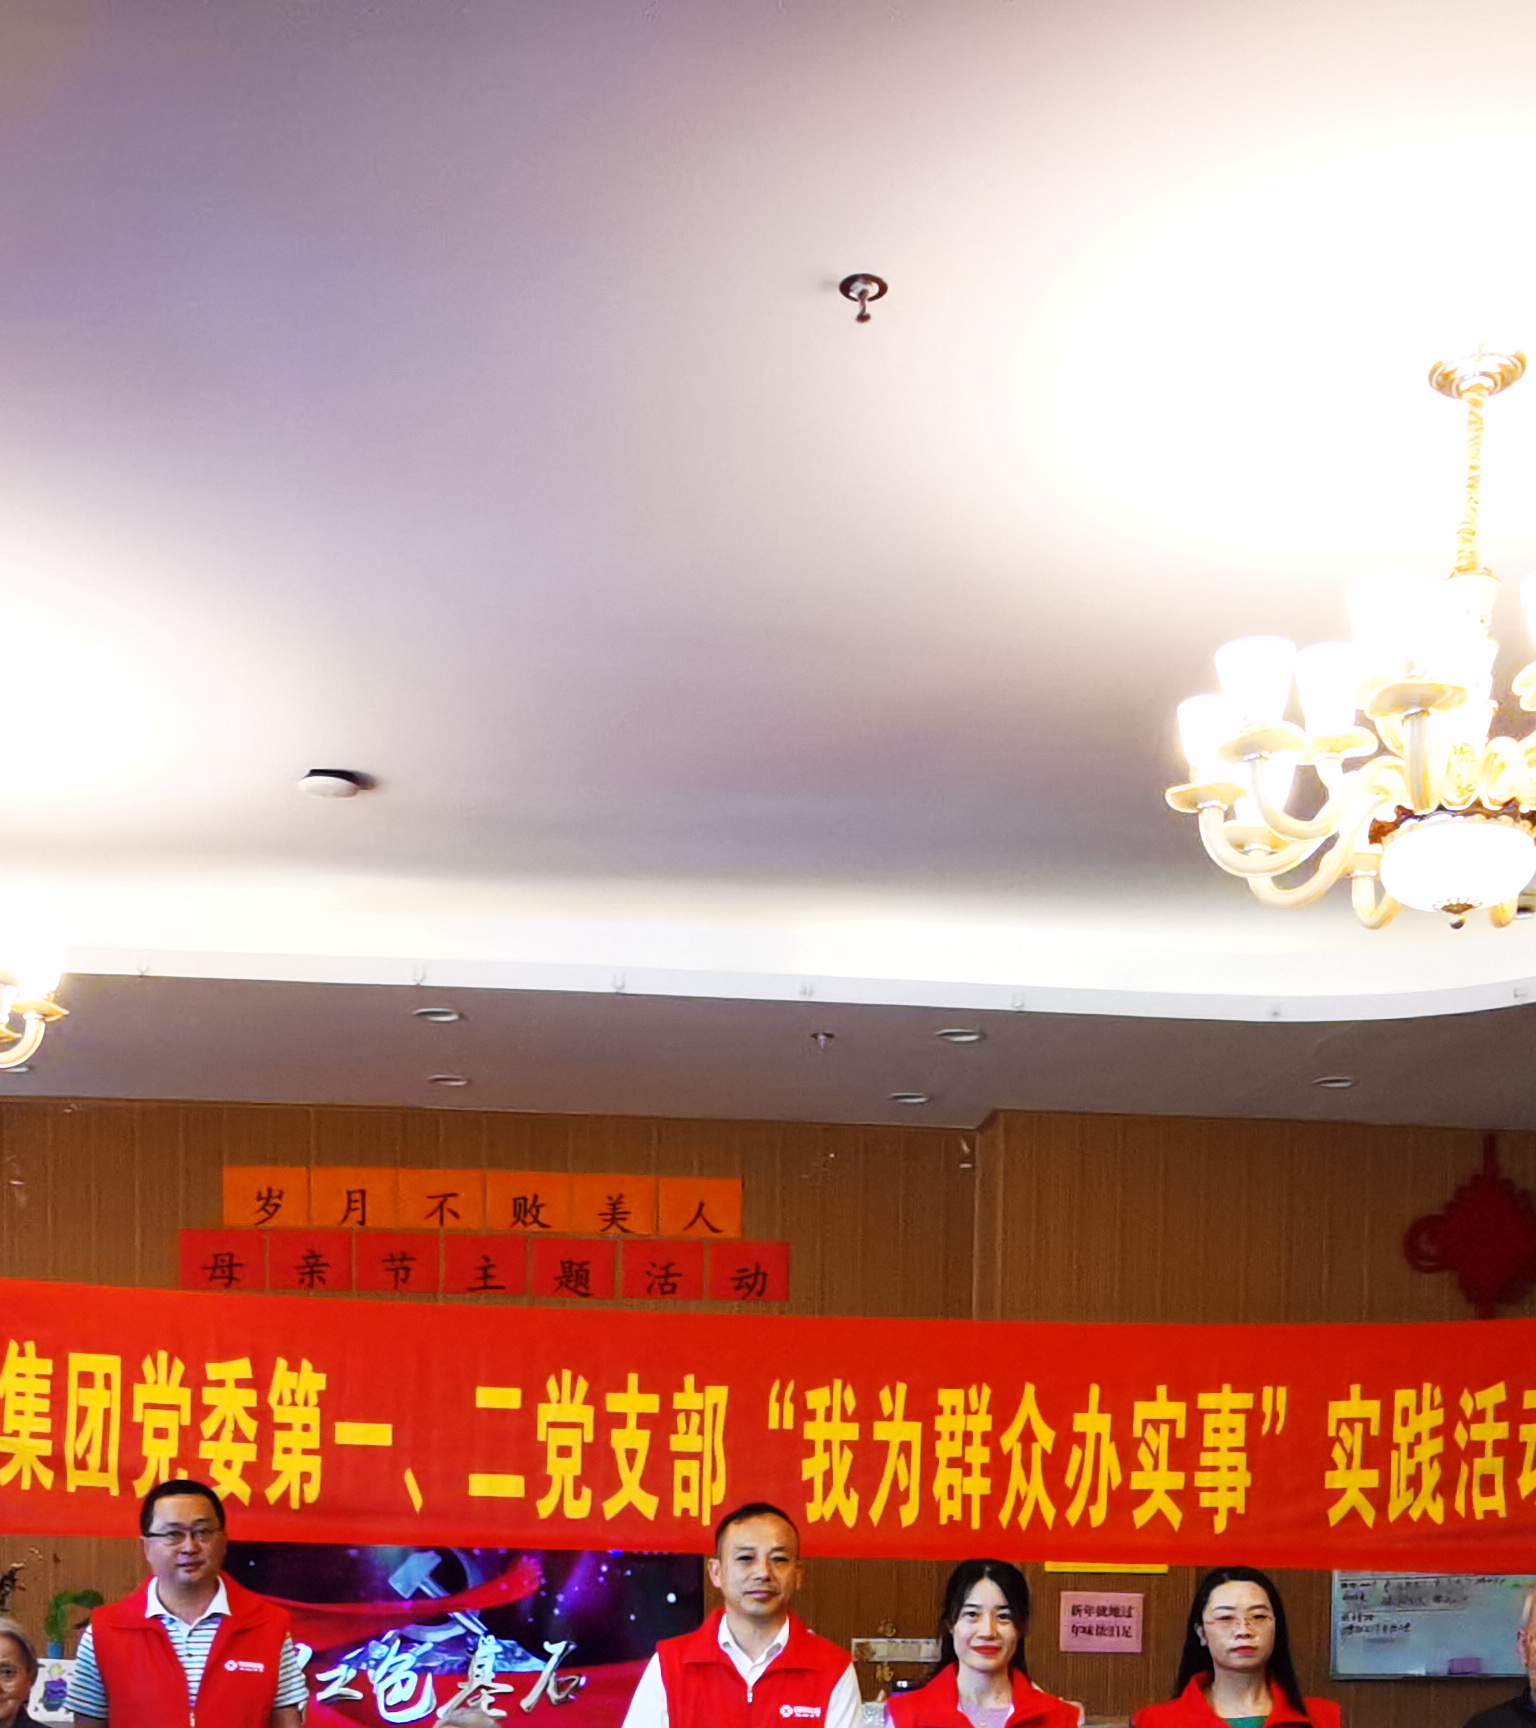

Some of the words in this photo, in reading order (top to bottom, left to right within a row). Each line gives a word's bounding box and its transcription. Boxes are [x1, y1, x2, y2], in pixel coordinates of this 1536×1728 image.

[254, 1186, 725, 1234] 岁月不败美人
[202, 1249, 769, 1300] 母亲节主题活动
